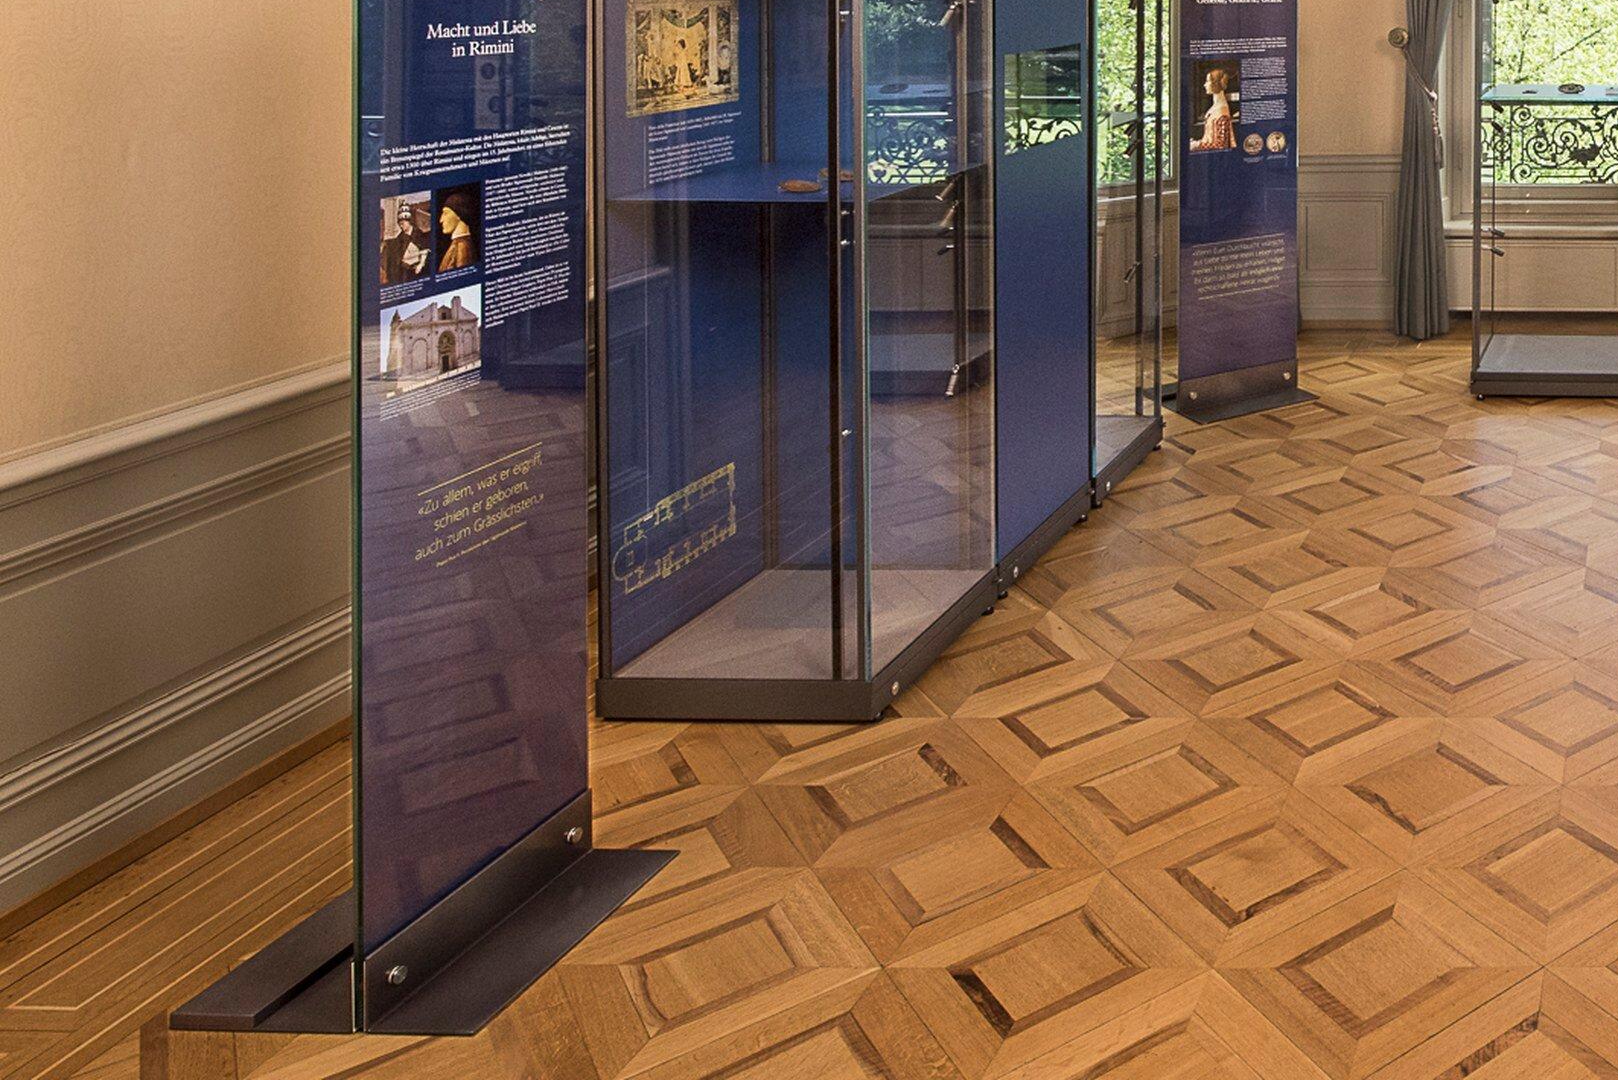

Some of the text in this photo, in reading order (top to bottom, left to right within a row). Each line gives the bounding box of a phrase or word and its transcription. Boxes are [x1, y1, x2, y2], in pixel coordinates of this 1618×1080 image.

[426, 20, 536, 39] Macht und Liebe
[452, 39, 514, 57] in Rimini
[443, 485, 474, 507] allem,
[477, 474, 497, 491] was
[500, 468, 510, 481] er
[434, 506, 469, 531] schien
[472, 499, 483, 513] er
[414, 537, 443, 561] auch
[447, 526, 471, 547] zum
